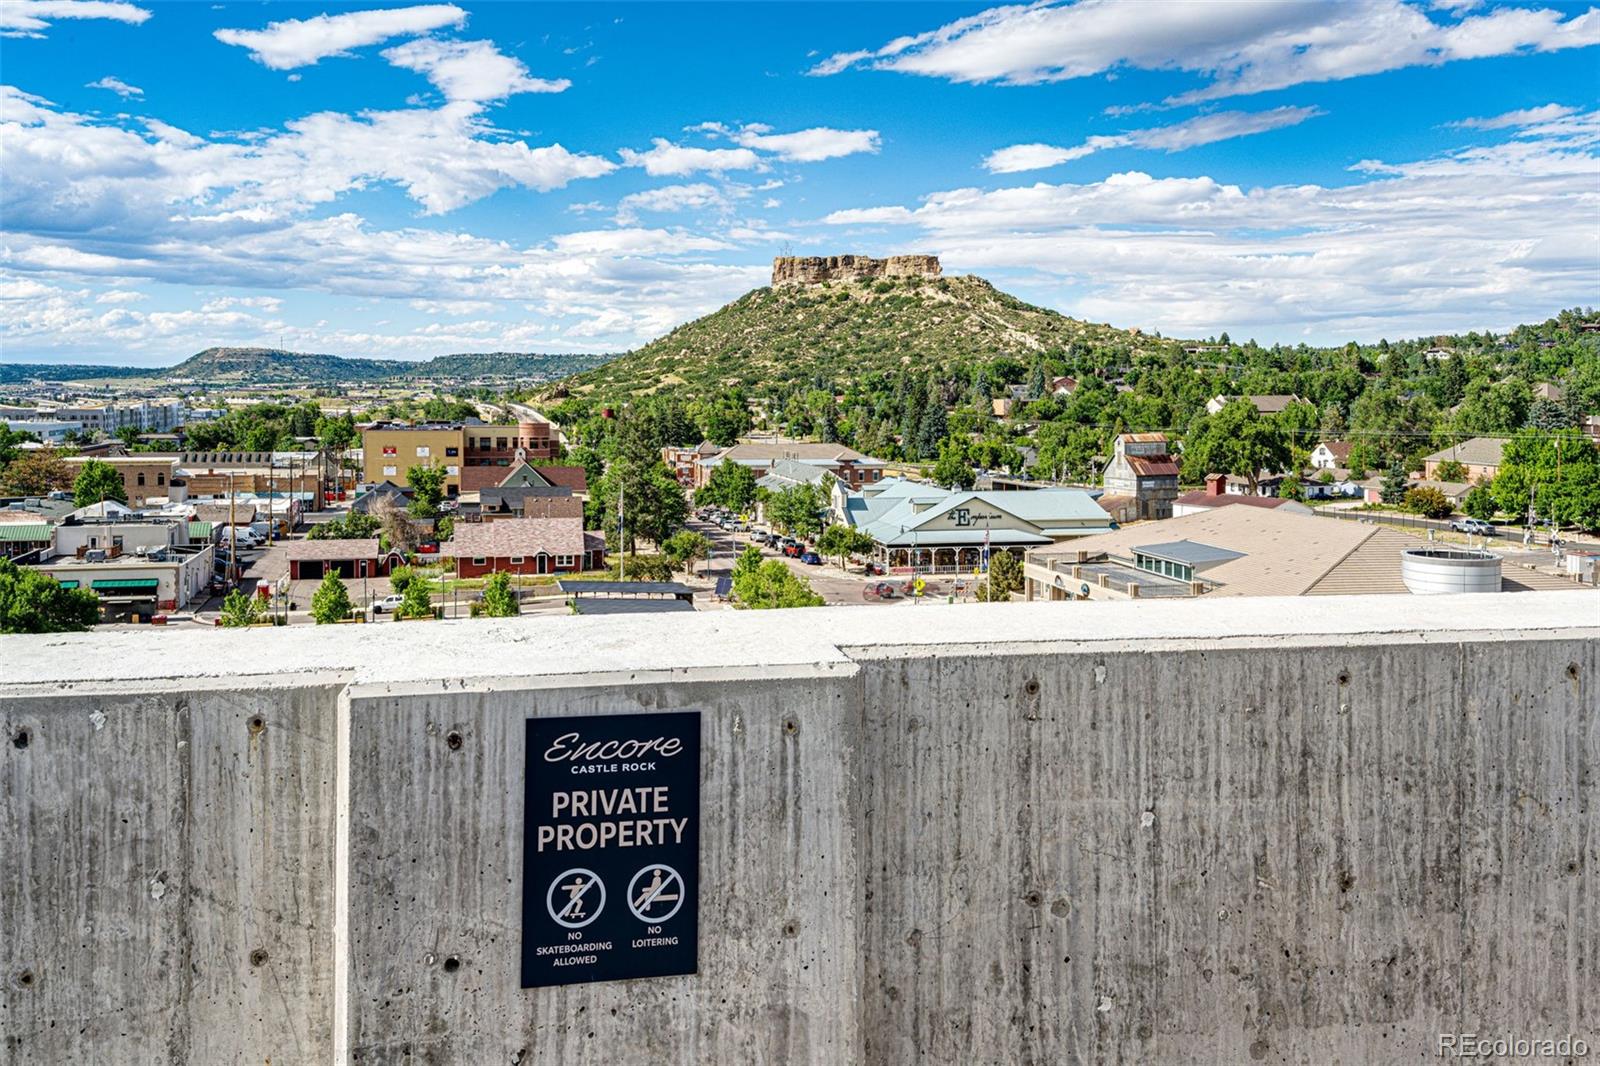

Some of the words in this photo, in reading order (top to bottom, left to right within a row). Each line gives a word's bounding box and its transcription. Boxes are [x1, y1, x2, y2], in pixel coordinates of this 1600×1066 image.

[947, 509, 956, 520] the
[543, 731, 684, 763] Encore
[570, 764, 618, 775] CASTLE
[622, 762, 656, 772] ROCK
[552, 786, 669, 818] PRIVATE
[537, 818, 689, 853] PROPERTY
[567, 932, 583, 941] NO
[647, 926, 662, 935] NO
[536, 941, 613, 957] SKATEBOARDING
[631, 936, 679, 949] LOITERING
[553, 955, 597, 967] ALLOWED
